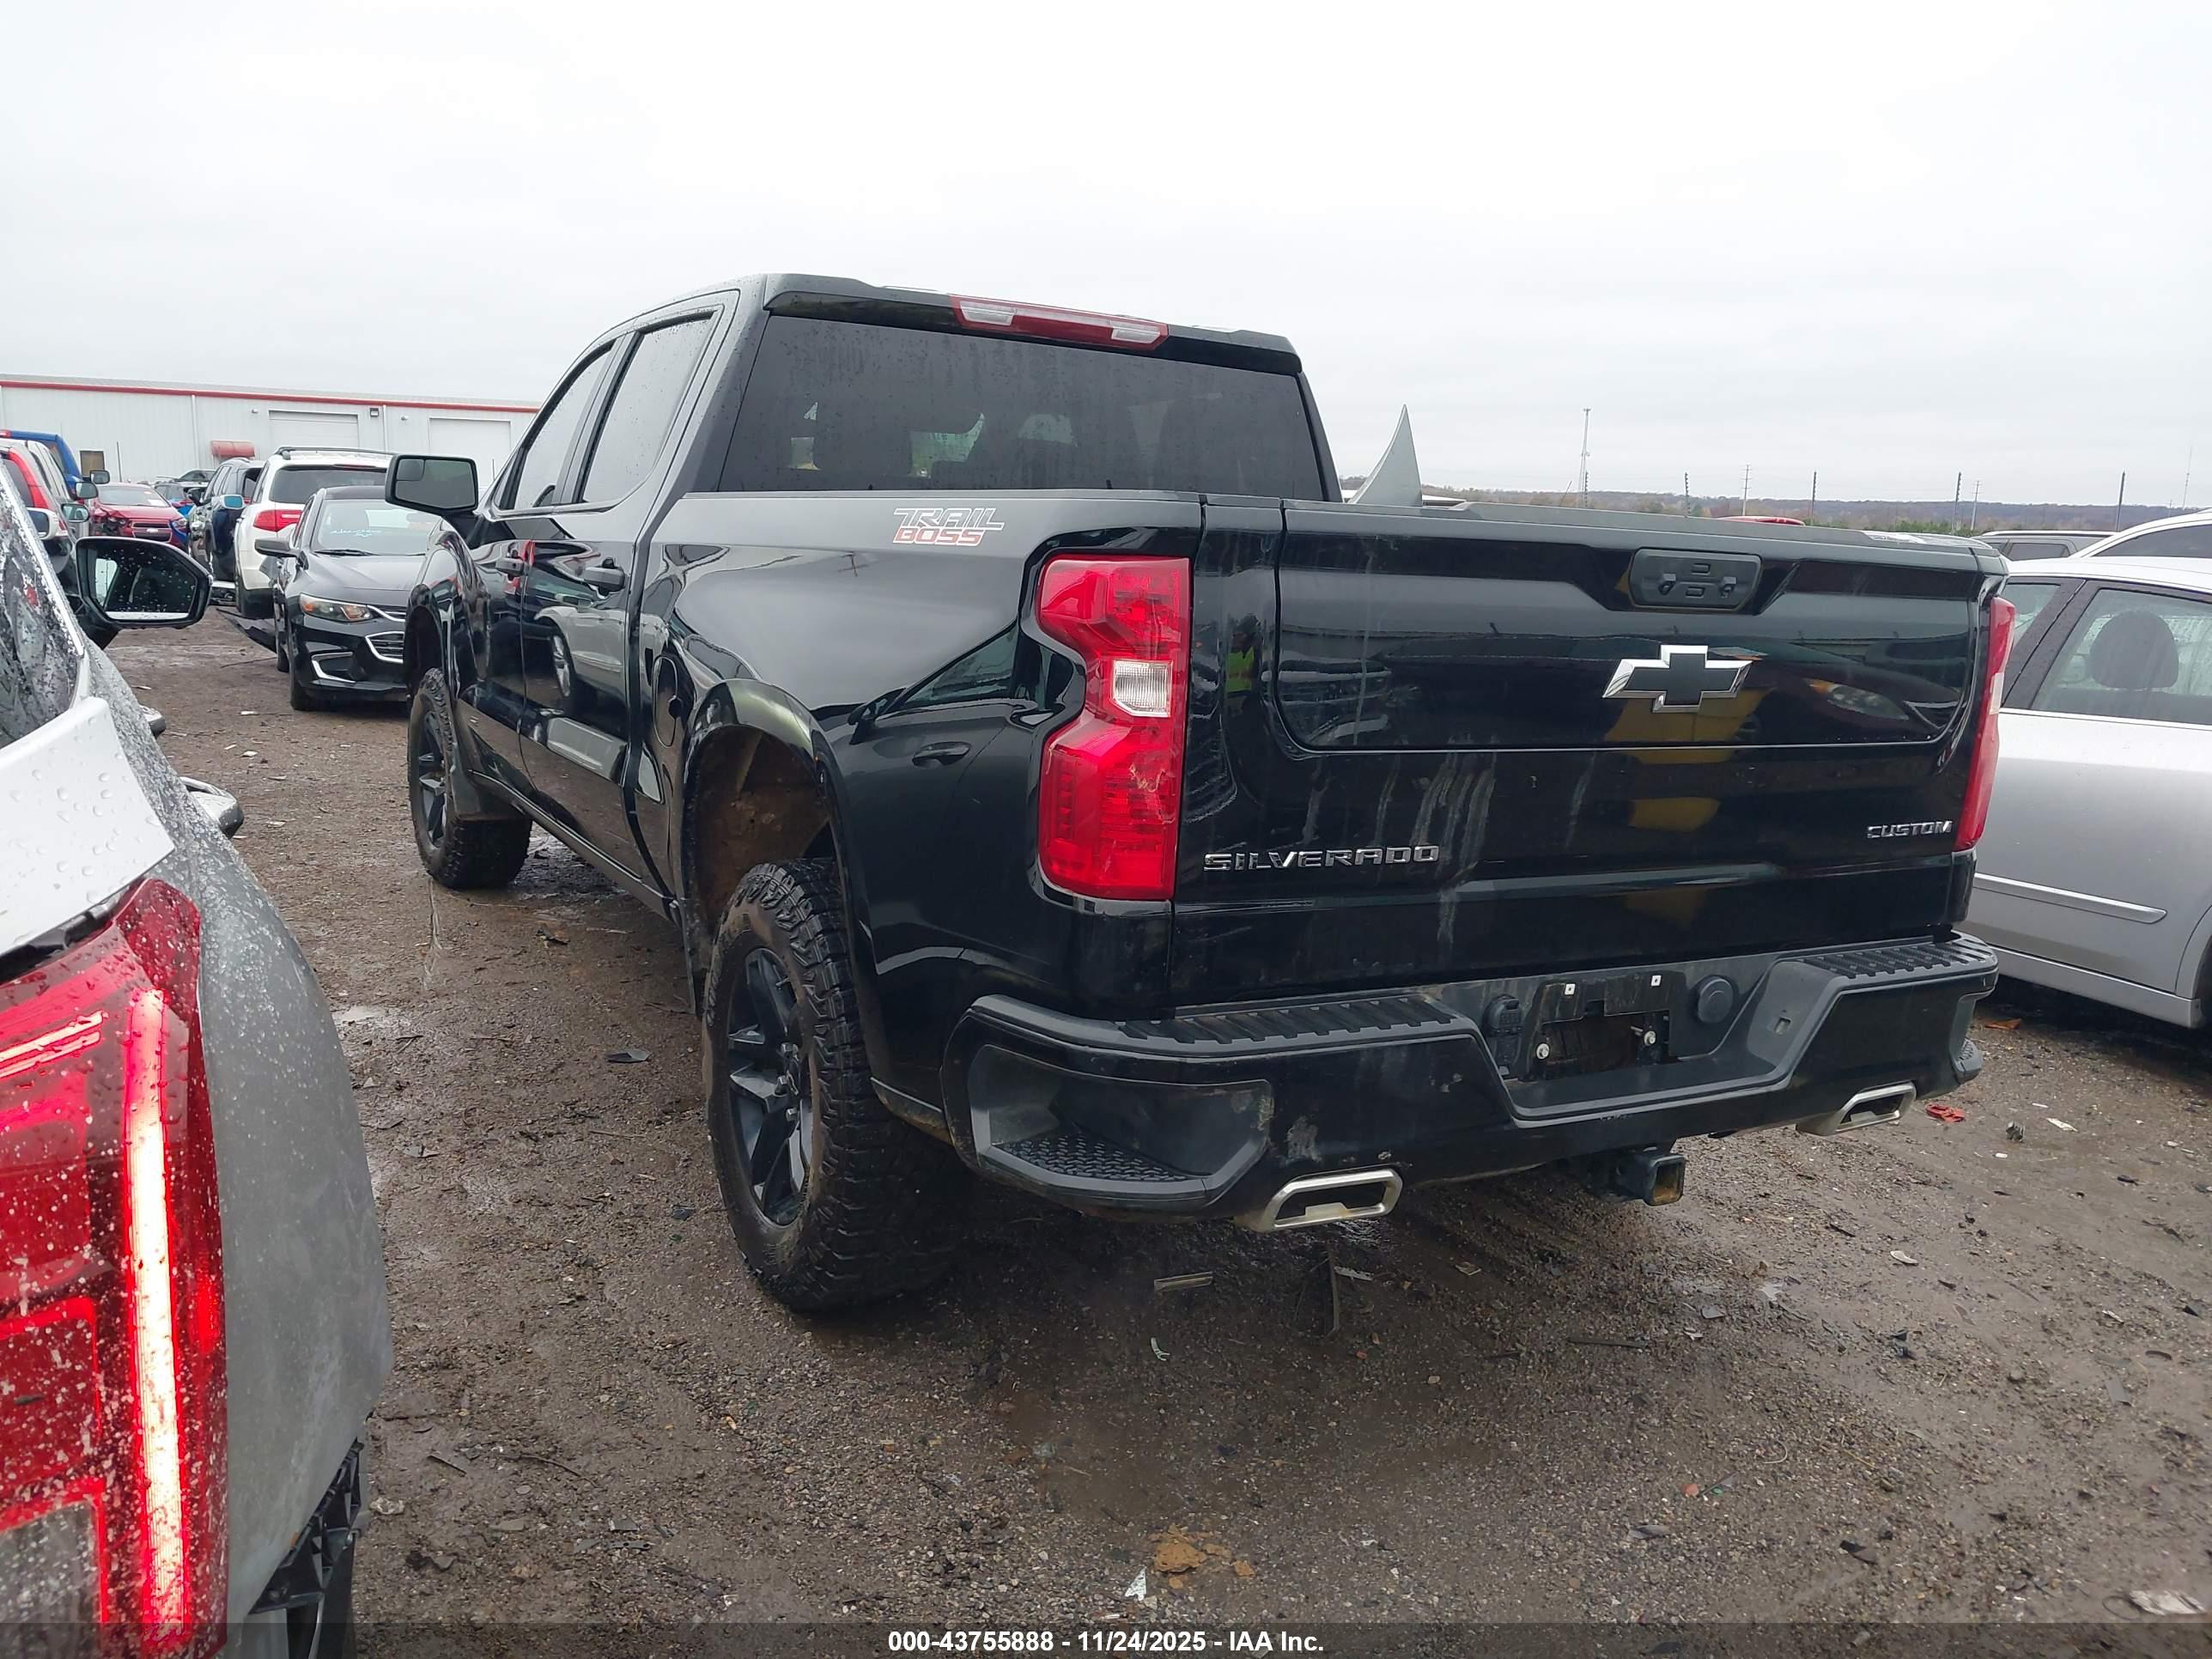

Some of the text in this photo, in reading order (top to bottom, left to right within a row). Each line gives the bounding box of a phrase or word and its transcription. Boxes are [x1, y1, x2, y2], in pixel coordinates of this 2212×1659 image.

[893, 507, 1005, 531] TRAIL
[892, 527, 985, 546] BOSS
[1867, 820, 1953, 839] CUSTOM
[1203, 845, 1439, 872] SILVERADO
